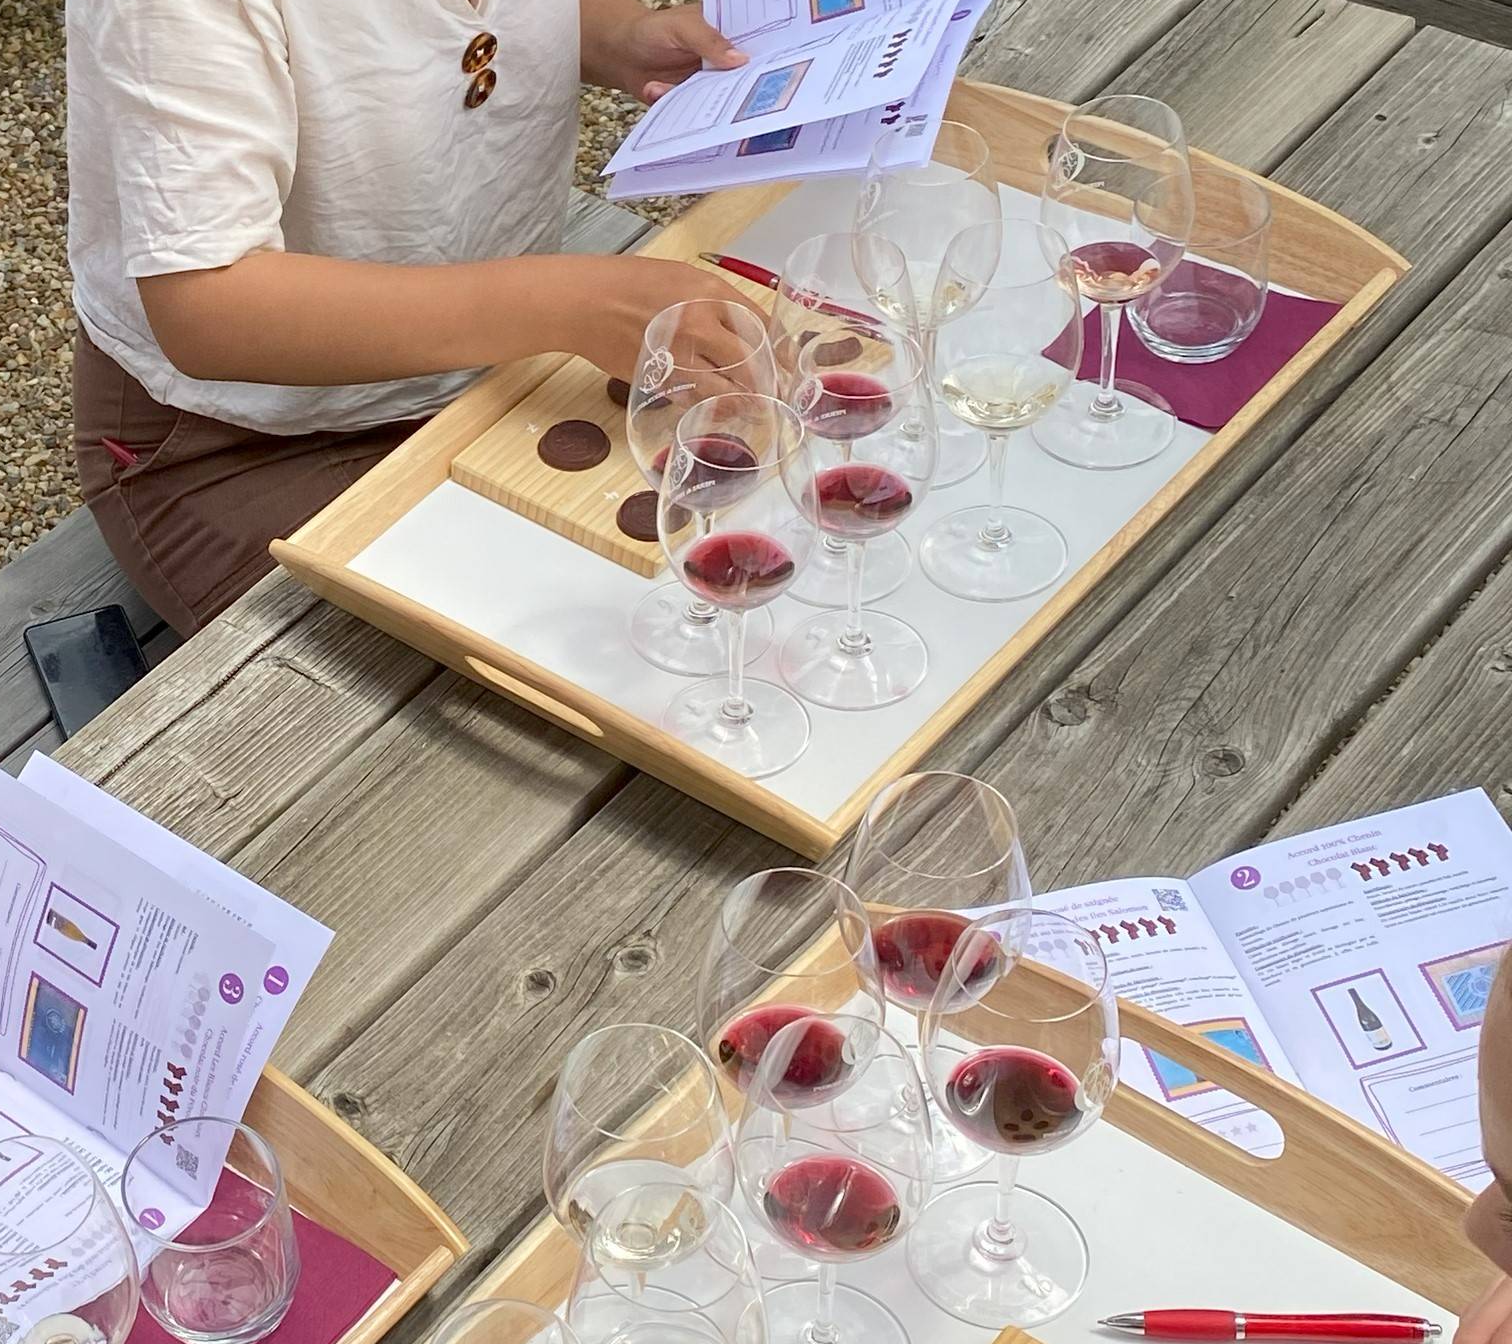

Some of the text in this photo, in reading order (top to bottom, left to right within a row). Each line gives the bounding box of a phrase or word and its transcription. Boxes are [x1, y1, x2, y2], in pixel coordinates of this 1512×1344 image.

[1288, 844, 1320, 858] Accord
[1347, 829, 1383, 843] Chenin
[1308, 844, 1378, 866] Chocolat Blanc
[1239, 869, 1255, 887] 2
[222, 979, 241, 999] 3
